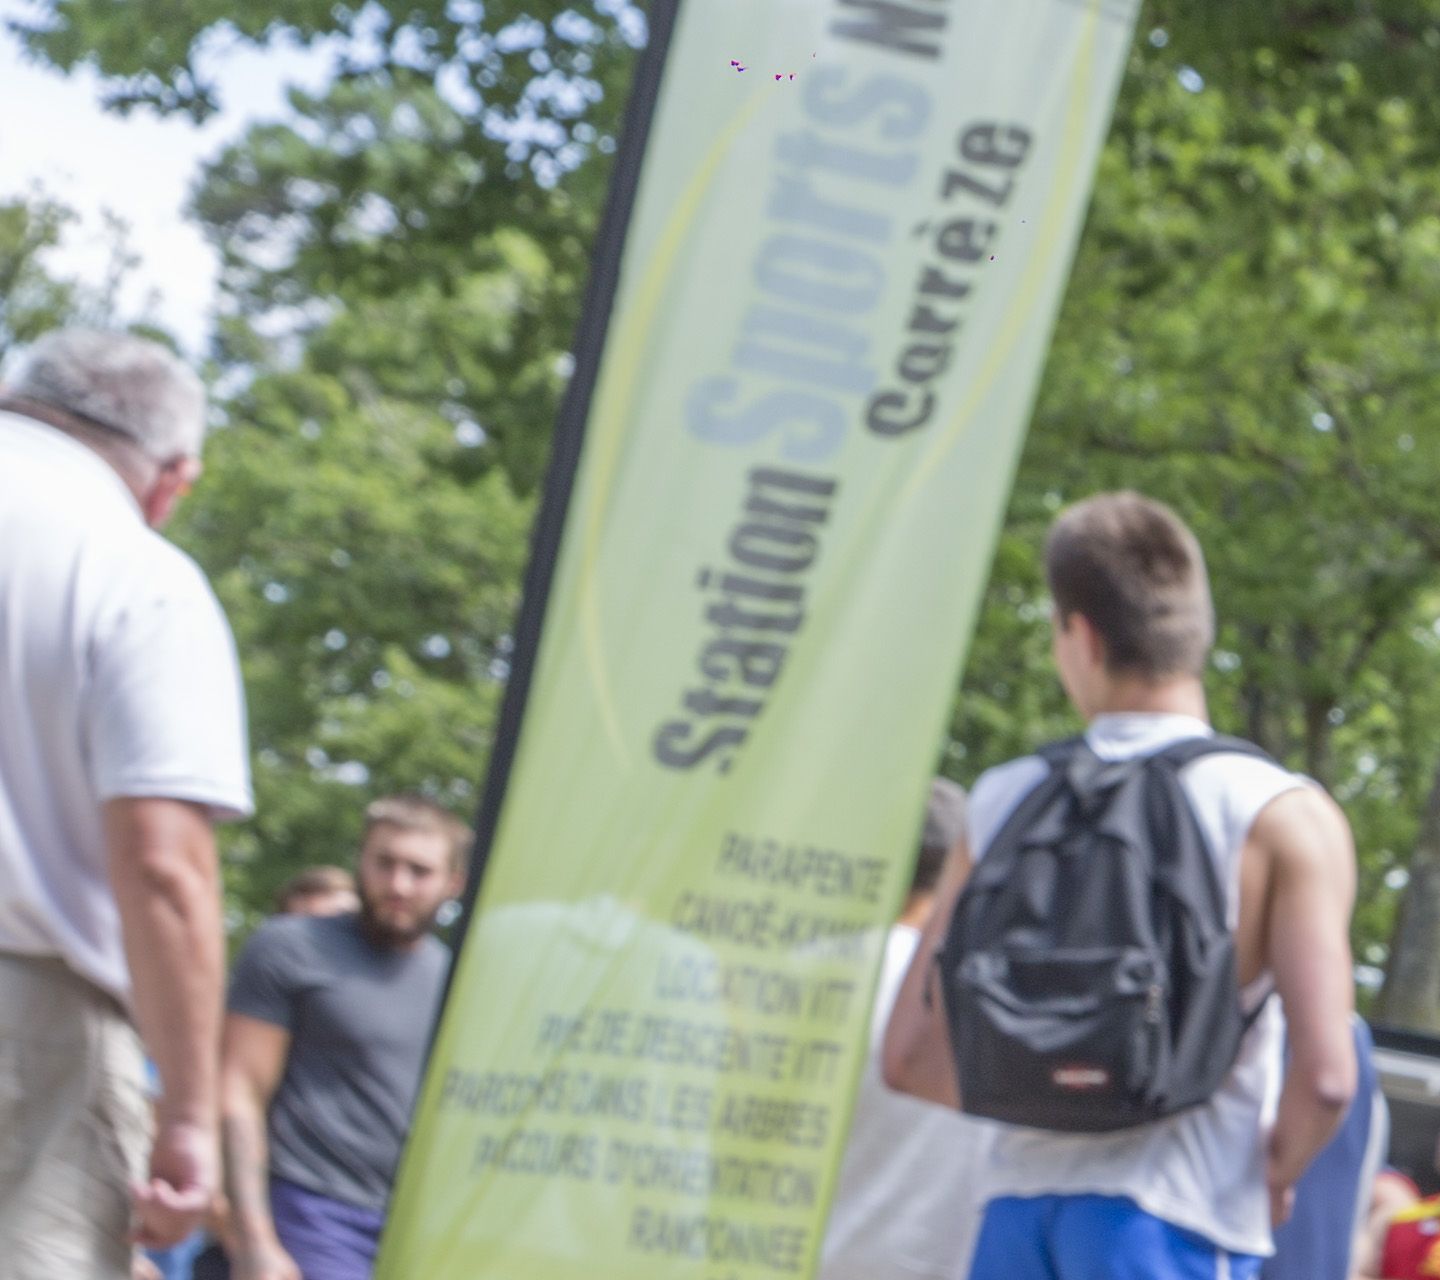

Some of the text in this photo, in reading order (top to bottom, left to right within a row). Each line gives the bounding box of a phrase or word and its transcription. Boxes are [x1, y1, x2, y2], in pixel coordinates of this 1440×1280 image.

[685, 64, 934, 462] Sports
[865, 118, 1034, 438] Corrèze
[653, 466, 840, 777] Station
